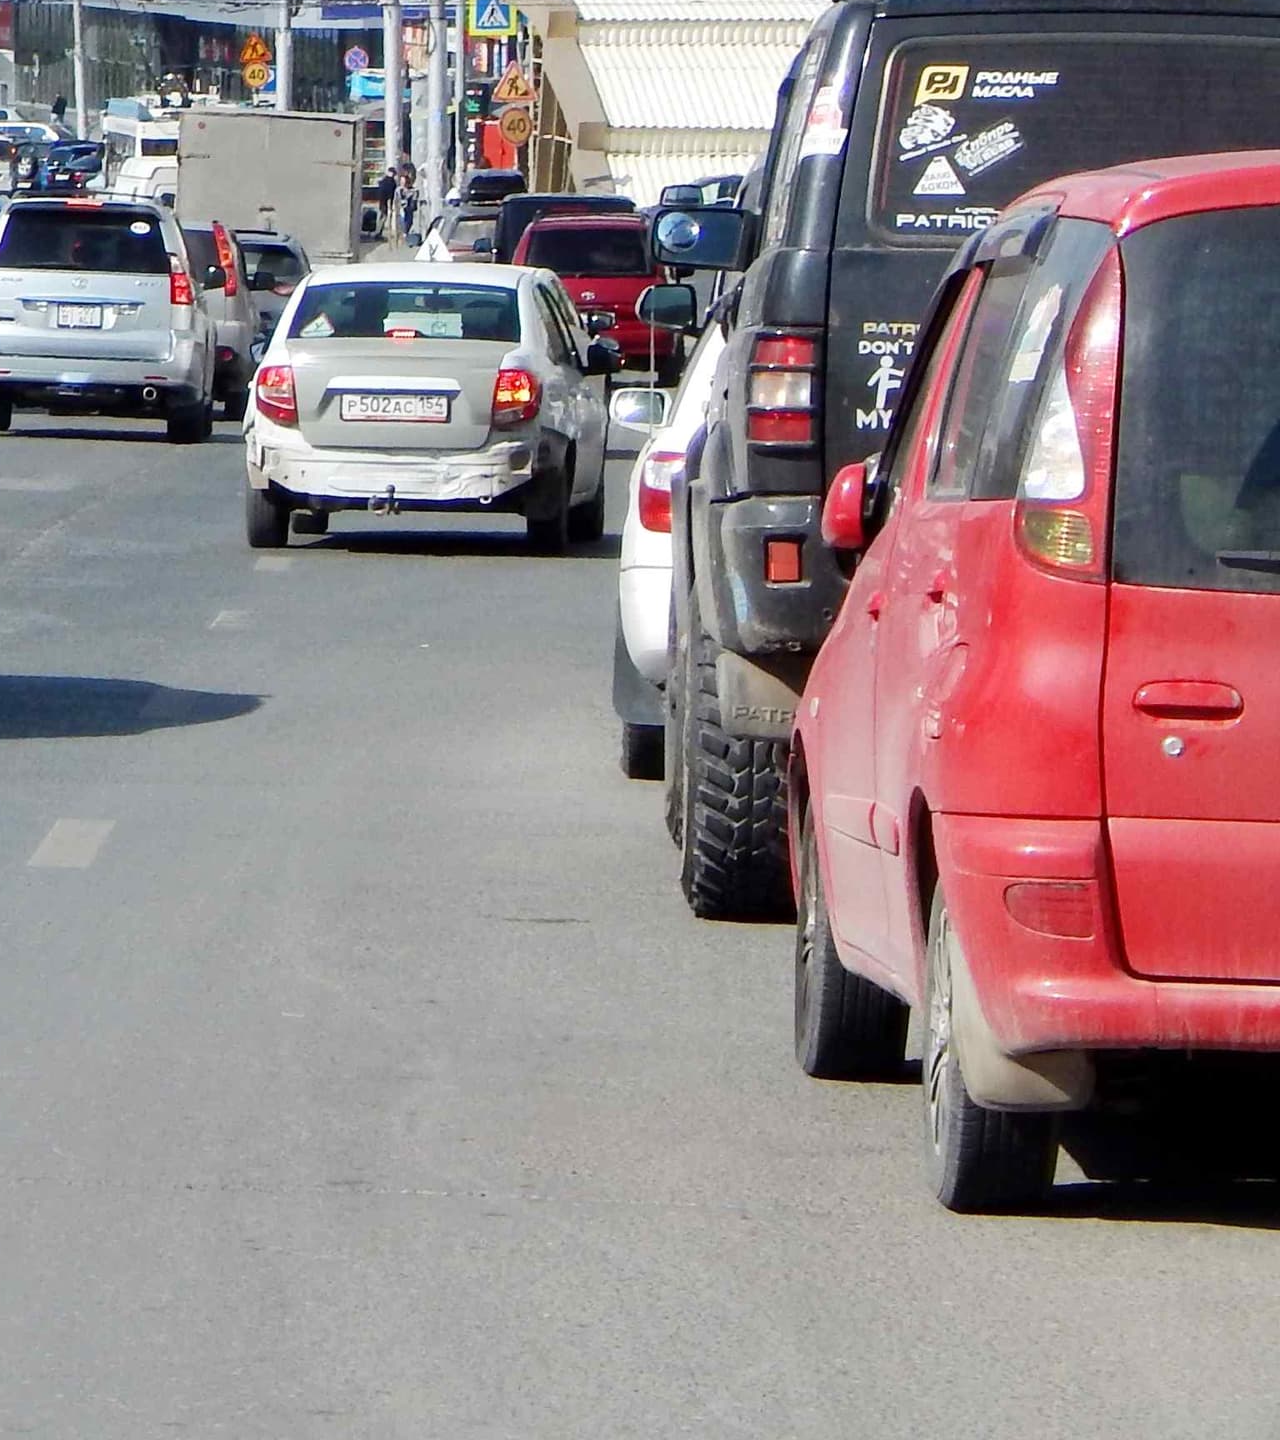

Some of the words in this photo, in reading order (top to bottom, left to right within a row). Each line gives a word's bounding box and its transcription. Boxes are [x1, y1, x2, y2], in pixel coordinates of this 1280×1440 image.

[248, 68, 265, 81] 40
[975, 71, 1059, 85] РОДНЫЕ
[972, 86, 1035, 98] МАСЛА
[506, 118, 527, 135] 40
[896, 214, 996, 229] PATRIO
[858, 339, 915, 355] DON'T
[419, 394, 444, 410] 154
[856, 408, 893, 430] MY
